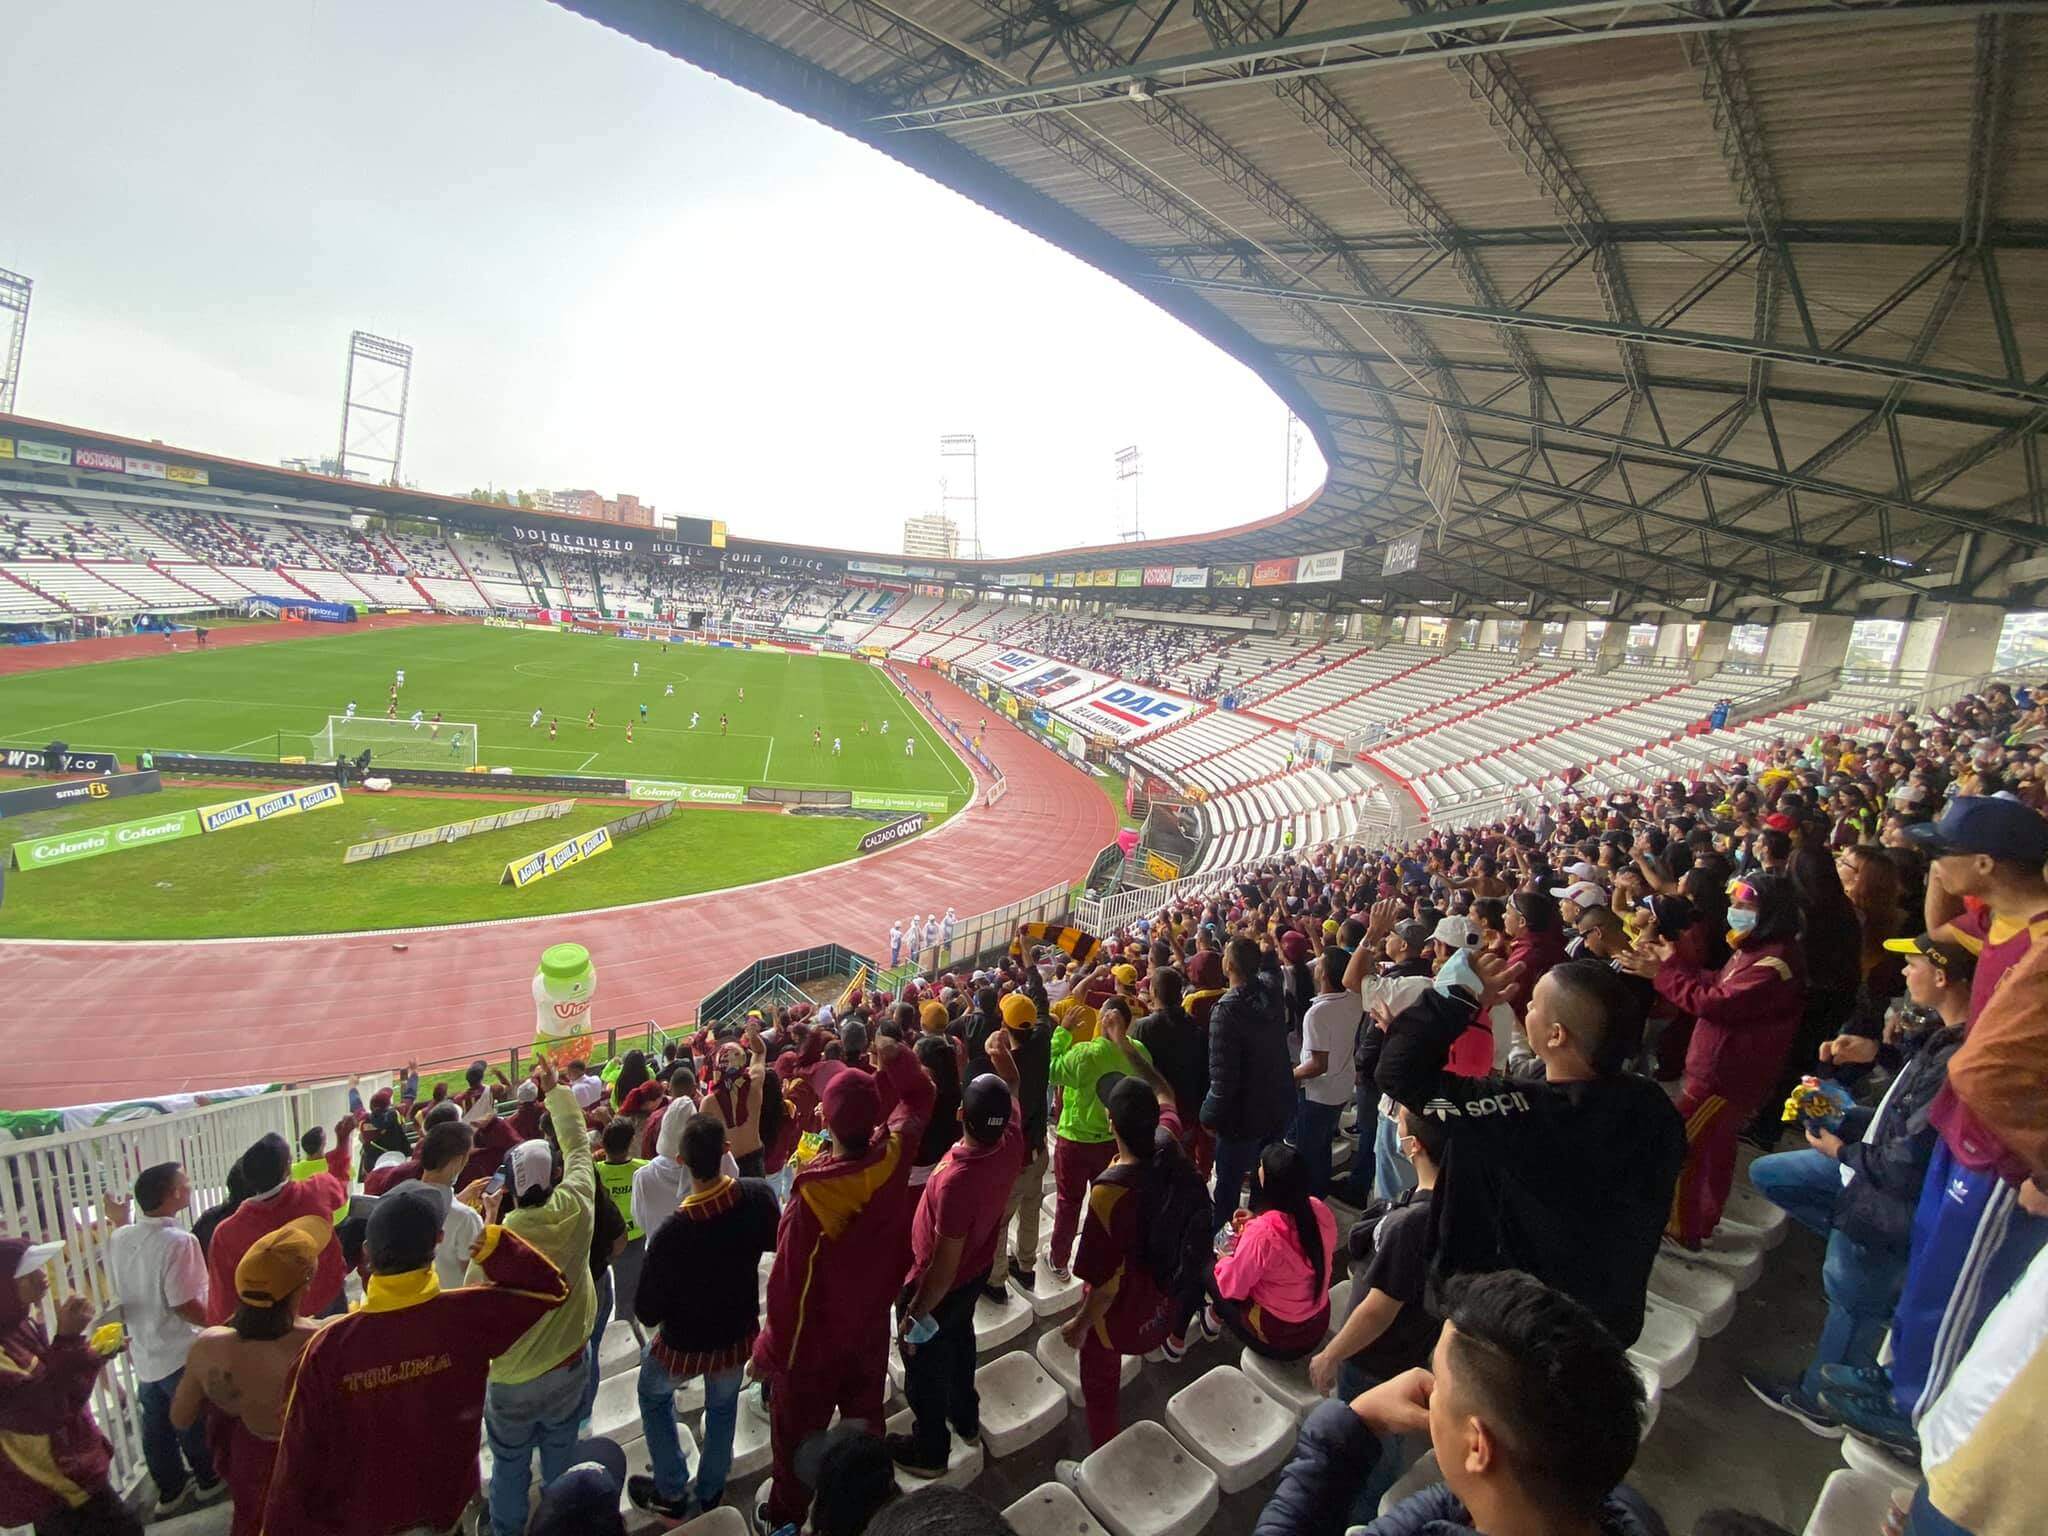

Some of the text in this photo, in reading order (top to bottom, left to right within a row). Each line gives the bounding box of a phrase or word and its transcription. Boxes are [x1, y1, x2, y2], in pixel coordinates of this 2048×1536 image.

[998, 653, 1037, 667] DAF
[1102, 688, 1183, 717] DAF
[212, 786, 335, 830] AGUILA AGUILA AGUILA
[636, 786, 738, 800] Colanta Colanta
[33, 821, 182, 859] Colanta Colanta
[865, 818, 922, 848] CALZADO GOLTY
[553, 840, 578, 869] AGUILA
[582, 830, 606, 857] AGUILA
